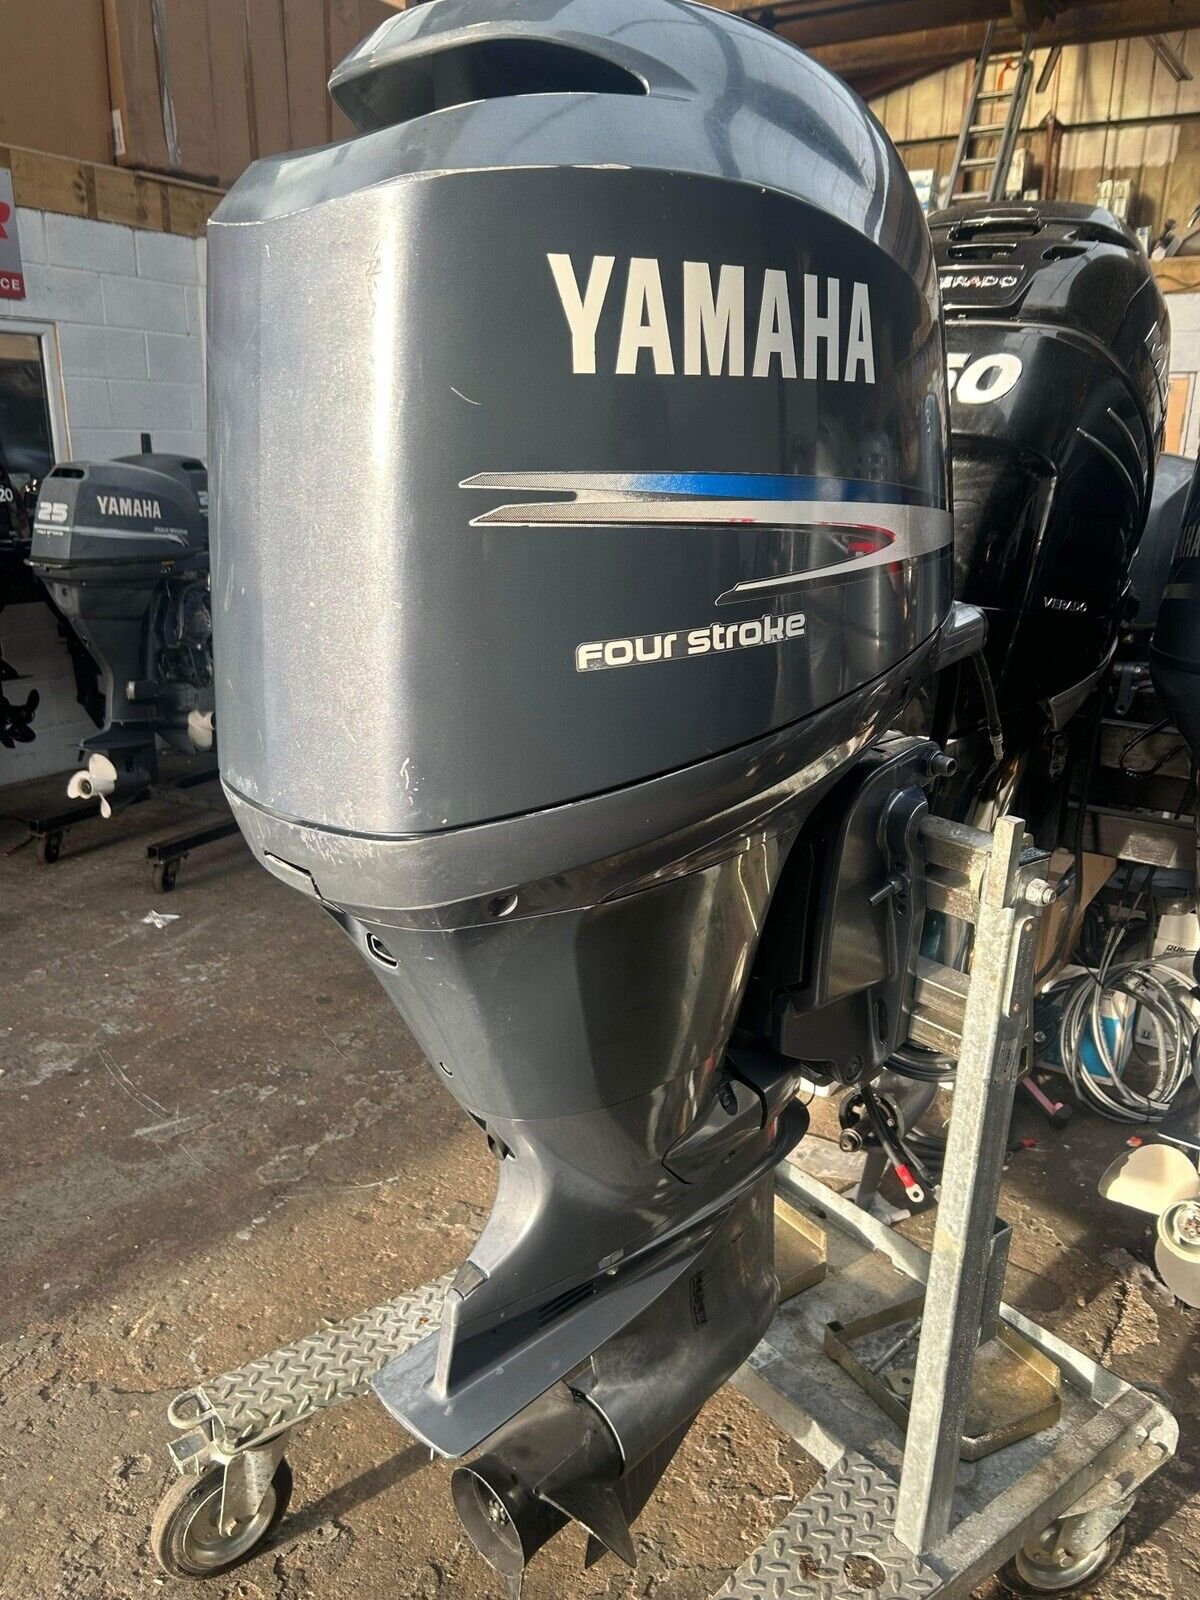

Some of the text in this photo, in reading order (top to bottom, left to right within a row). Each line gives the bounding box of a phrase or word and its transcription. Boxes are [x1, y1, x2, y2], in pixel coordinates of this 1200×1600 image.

[547, 253, 876, 384] YAMAHA
[37, 502, 69, 522] 25
[96, 495, 162, 519] YAMAHA
[687, 611, 806, 655] stroke
